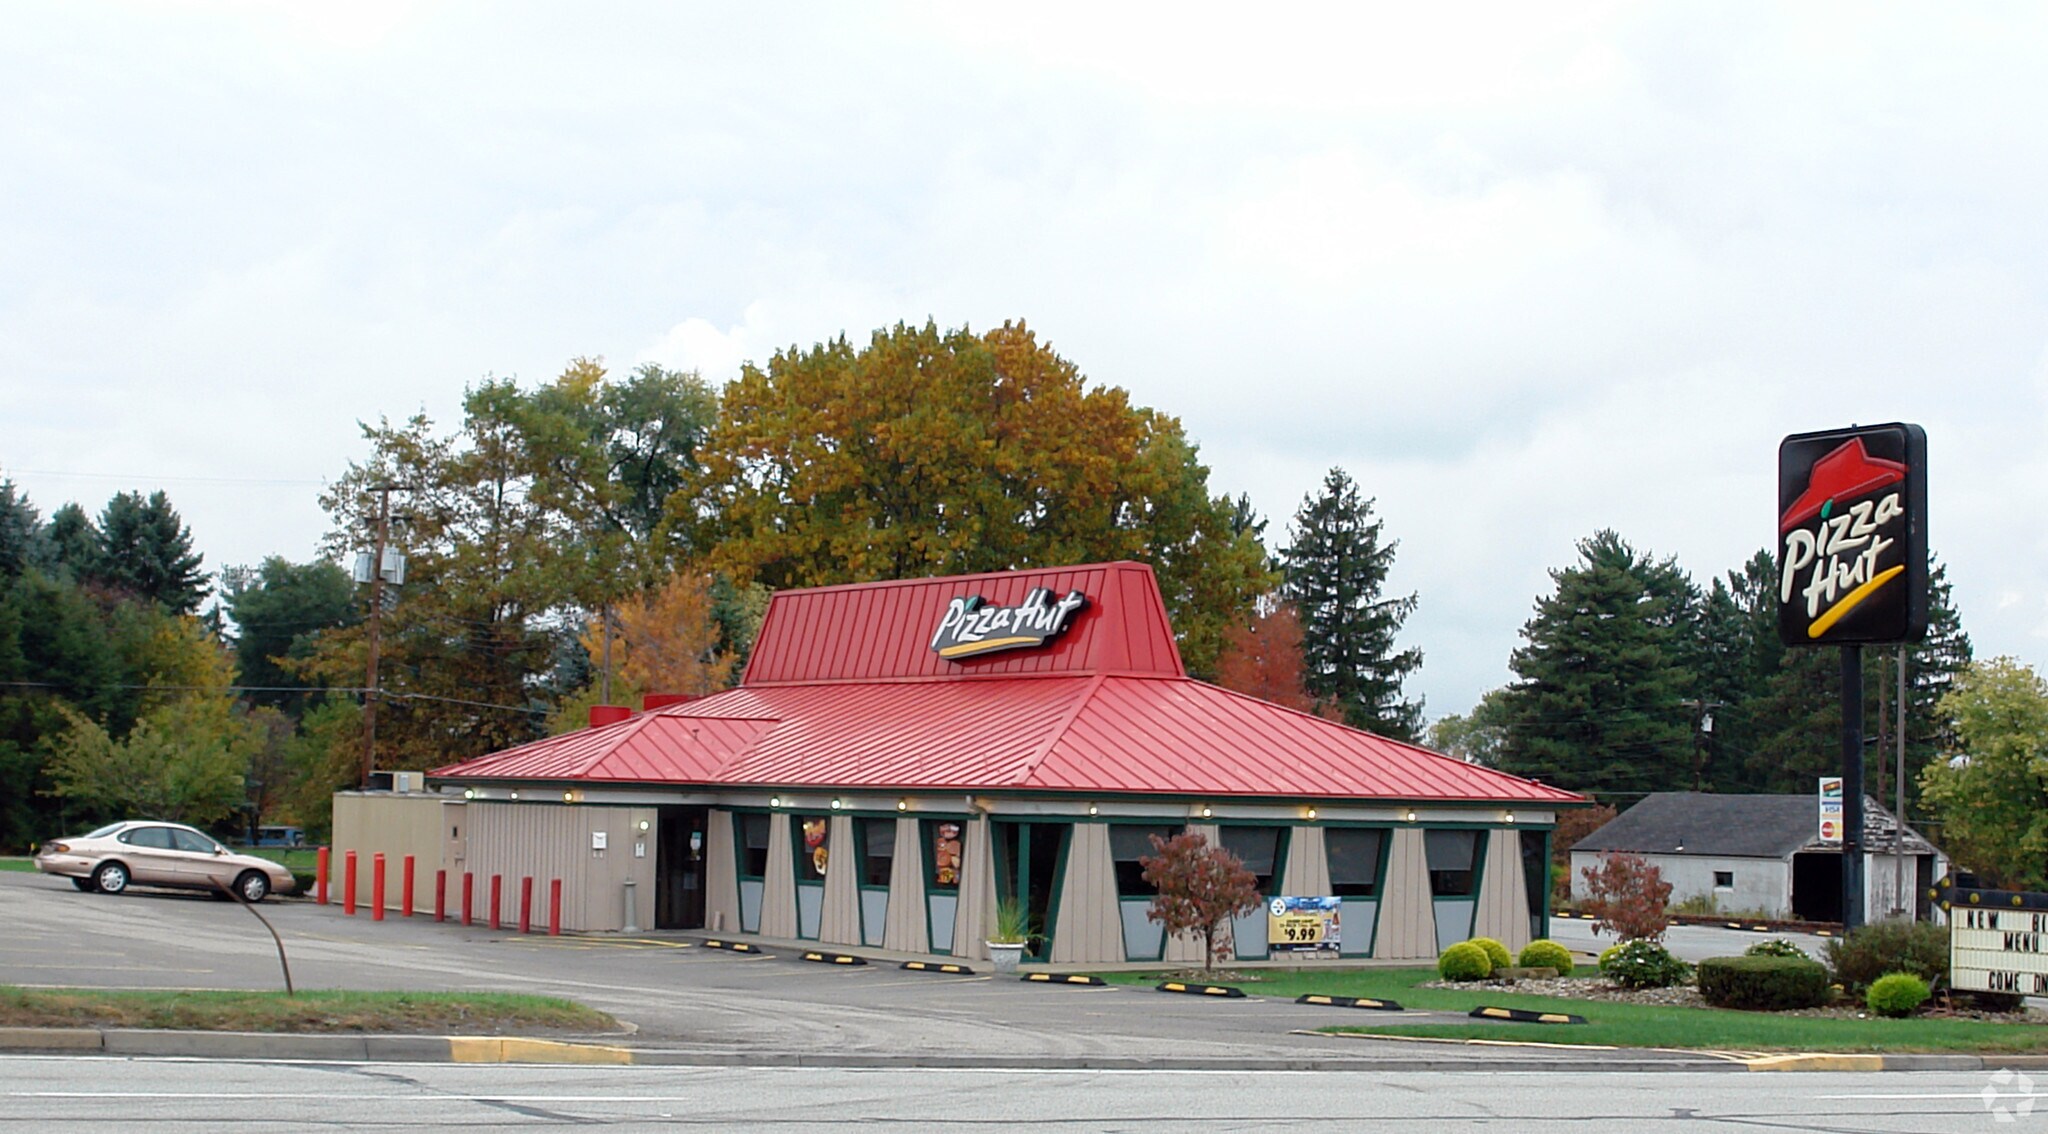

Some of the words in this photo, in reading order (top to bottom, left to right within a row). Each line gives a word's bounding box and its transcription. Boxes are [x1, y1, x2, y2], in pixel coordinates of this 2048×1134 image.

[1781, 493, 1903, 603] Pizza
[1802, 535, 1894, 618] Hut
[931, 596, 1011, 648] Pizza
[1011, 588, 1083, 634] Hut
[1967, 909, 1999, 929] NEW
[2003, 932, 2039, 953] MENU
[1988, 971, 2020, 993] COME
